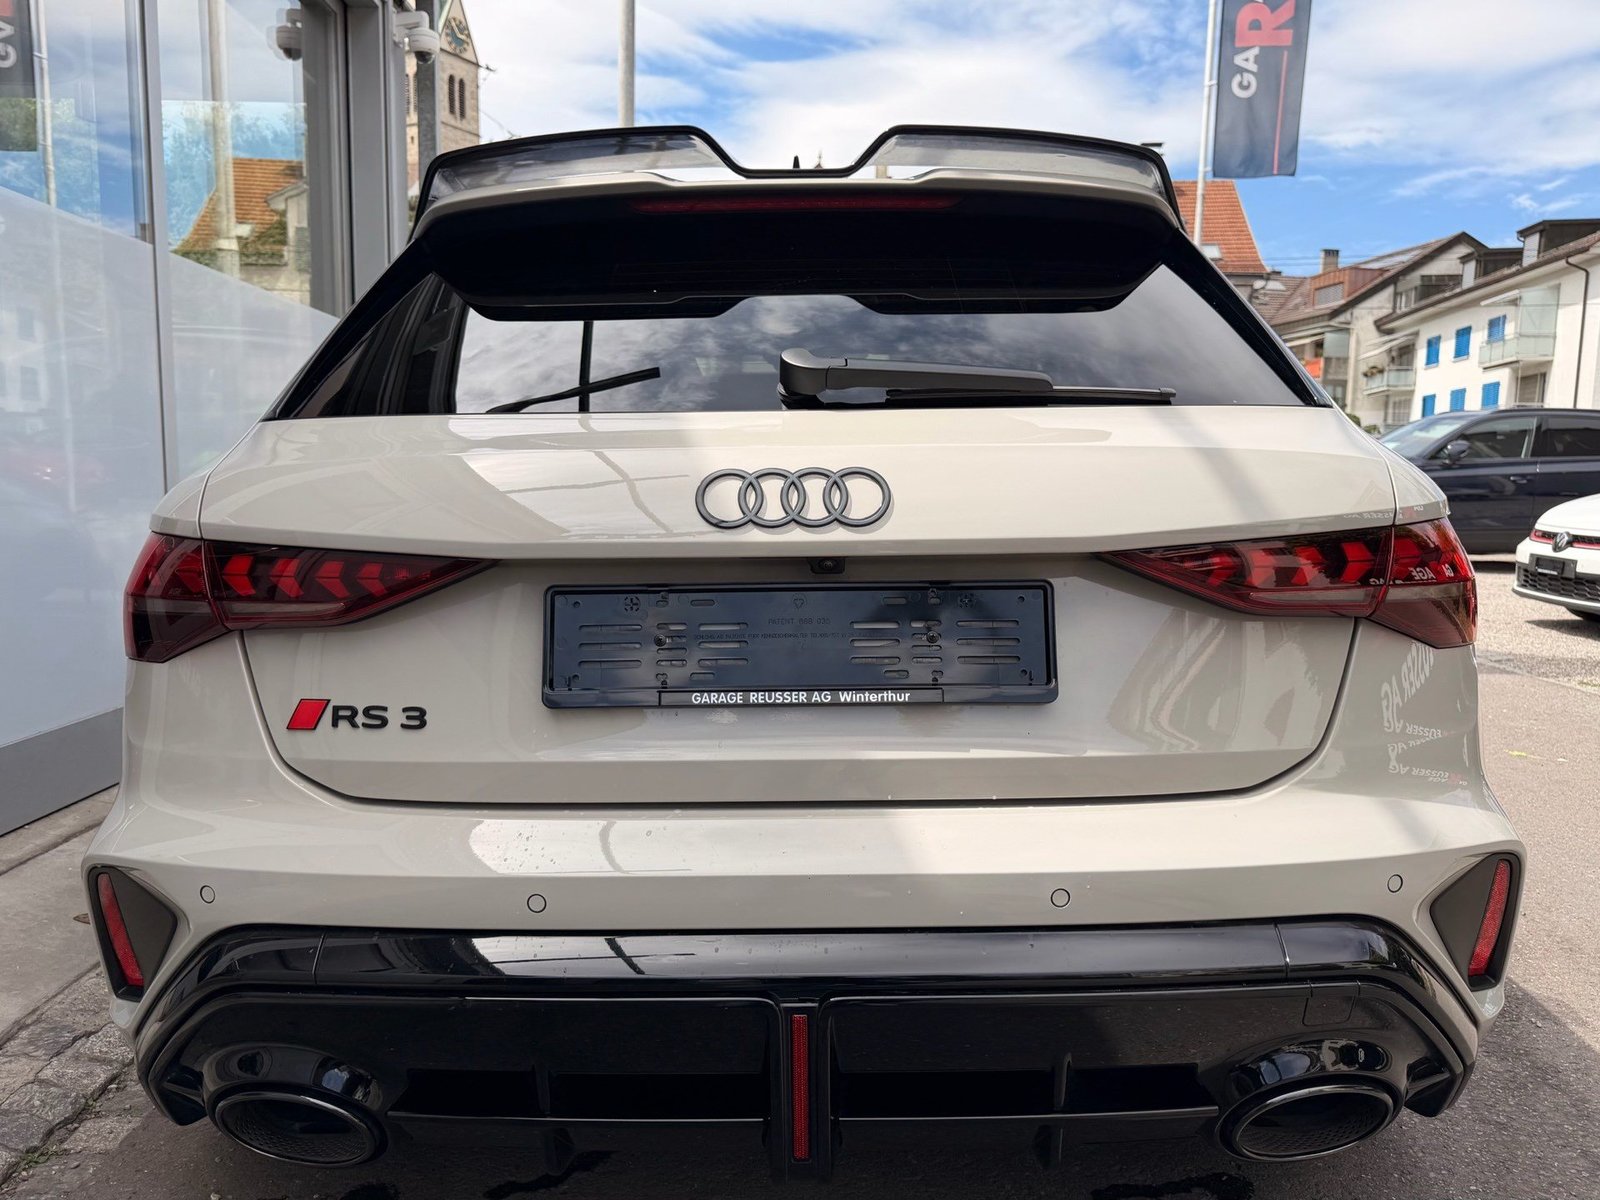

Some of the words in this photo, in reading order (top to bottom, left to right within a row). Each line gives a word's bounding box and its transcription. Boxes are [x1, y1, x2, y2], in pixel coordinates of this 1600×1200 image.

[1231, 0, 1296, 98] GAR
[691, 692, 744, 704] GARAGE
[750, 691, 807, 703] REUSSER
[811, 691, 832, 703] AG
[838, 691, 911, 703] Winterthur
[331, 705, 389, 729] RS
[400, 706, 427, 730] 3
